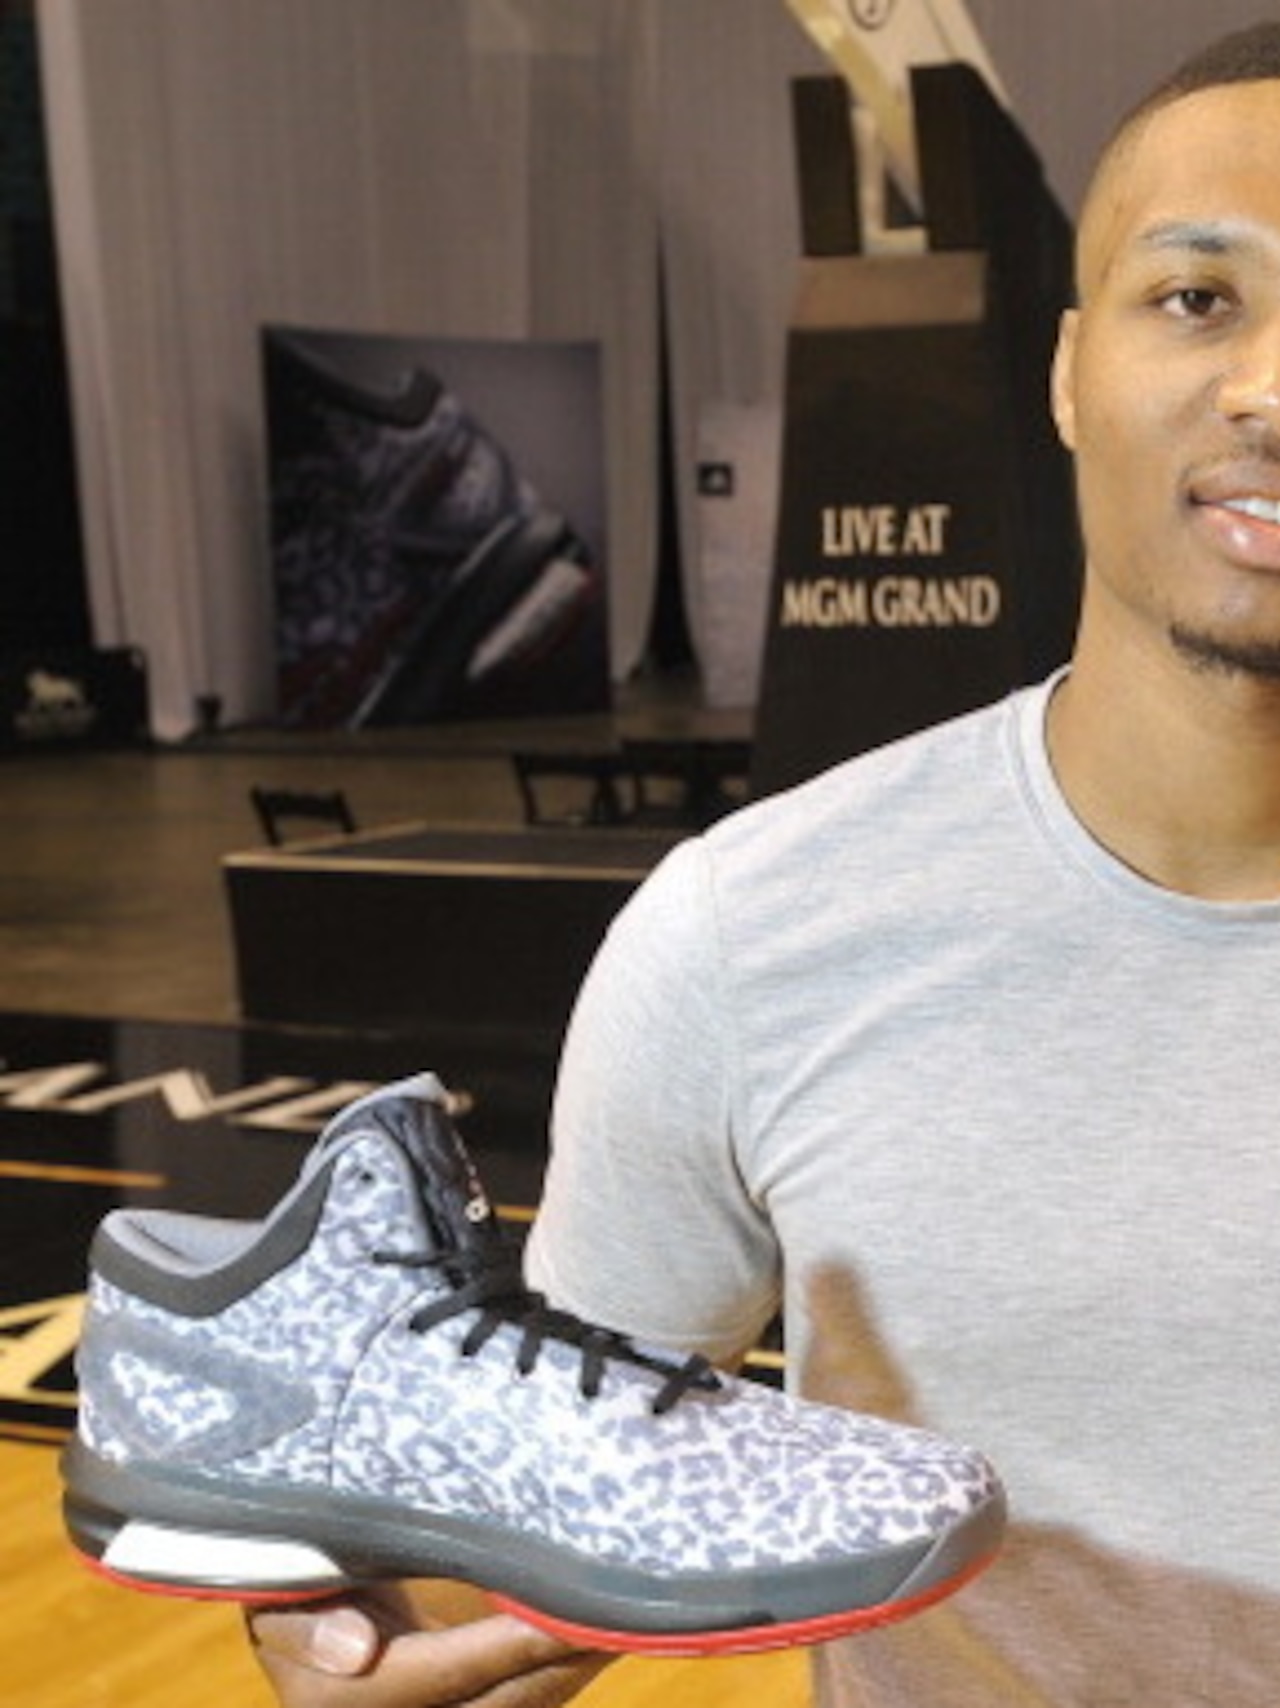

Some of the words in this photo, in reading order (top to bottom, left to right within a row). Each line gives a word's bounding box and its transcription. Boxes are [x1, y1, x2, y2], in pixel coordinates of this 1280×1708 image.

[822, 506, 896, 556] LIVE
[902, 503, 951, 556] AT
[781, 576, 868, 628] MGM
[871, 574, 1000, 628] GRAND
